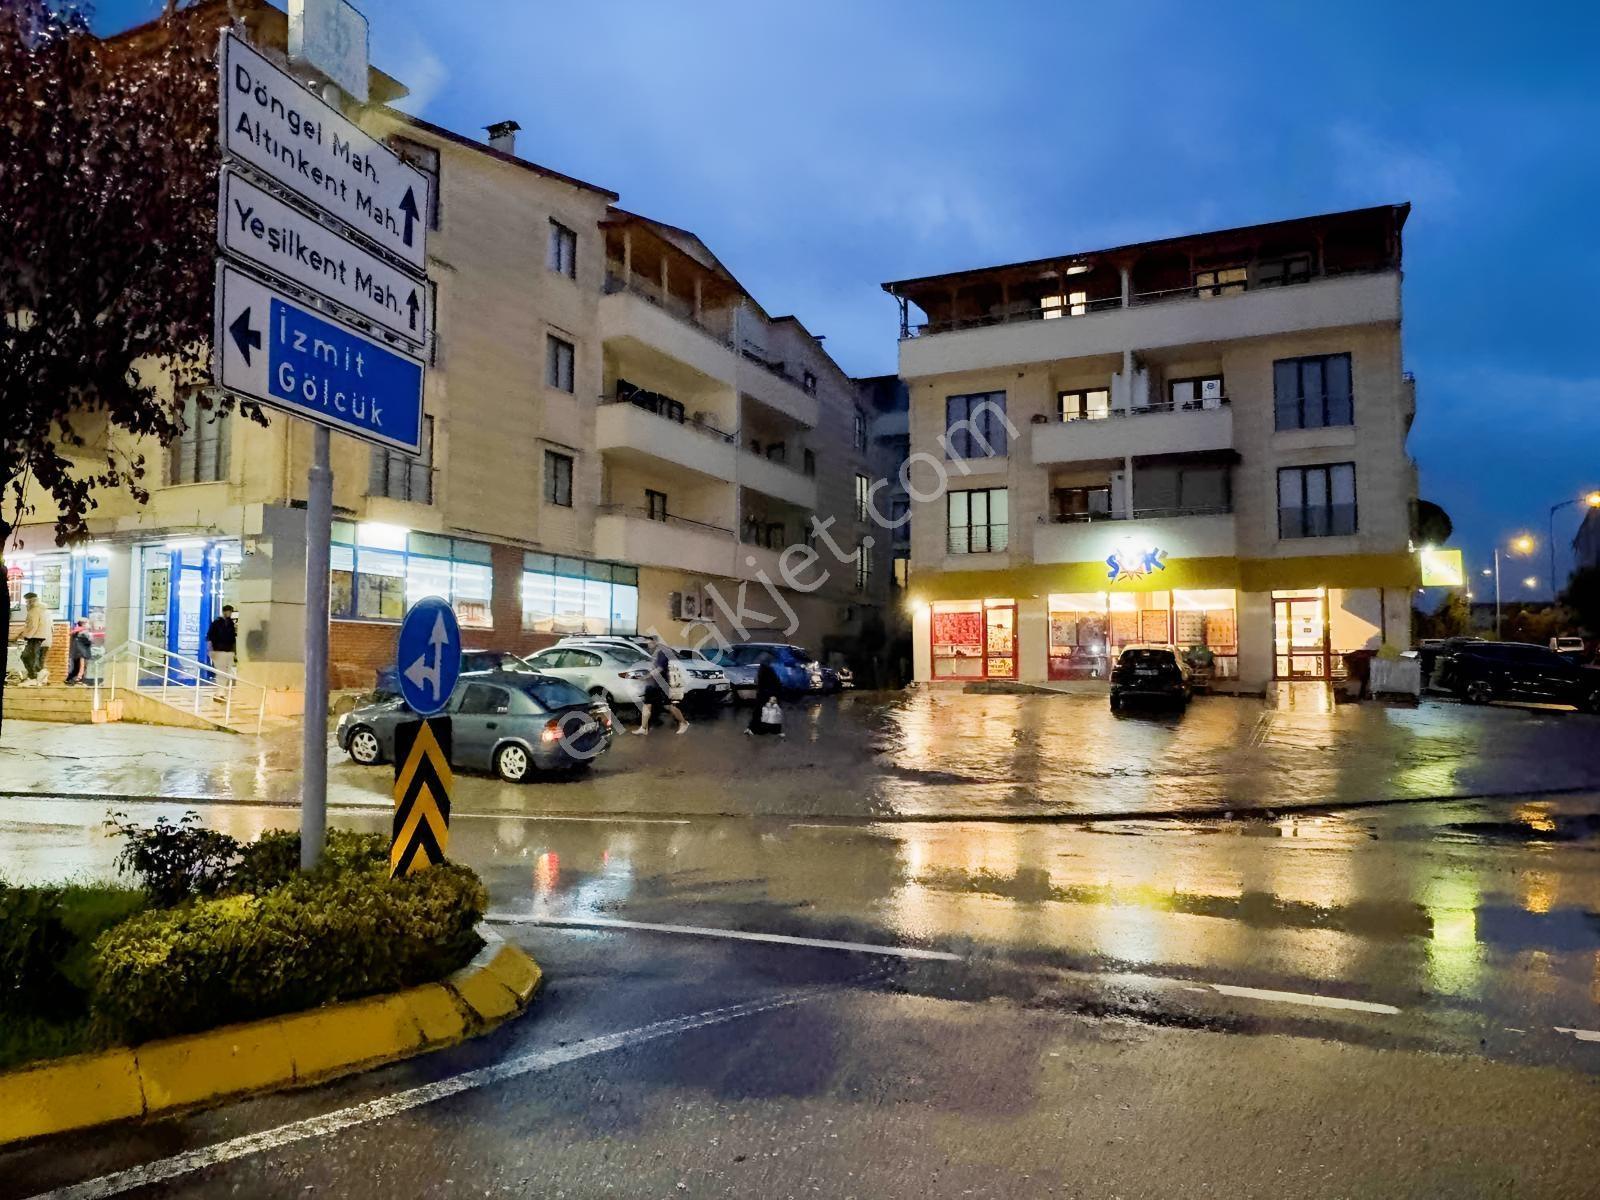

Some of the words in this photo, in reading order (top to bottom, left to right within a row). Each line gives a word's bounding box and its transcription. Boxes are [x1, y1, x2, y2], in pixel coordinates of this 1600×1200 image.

[235, 64, 322, 145] Döngel
[332, 132, 380, 184] Mah.
[235, 112, 347, 202] Altınkent
[356, 189, 400, 236] Mah.
[235, 199, 347, 285] Yeşilkent
[355, 267, 402, 315] Mah.
[279, 307, 364, 378] İzmit
[278, 362, 384, 427] Gölcük
[1106, 546, 1167, 585] ŞK
